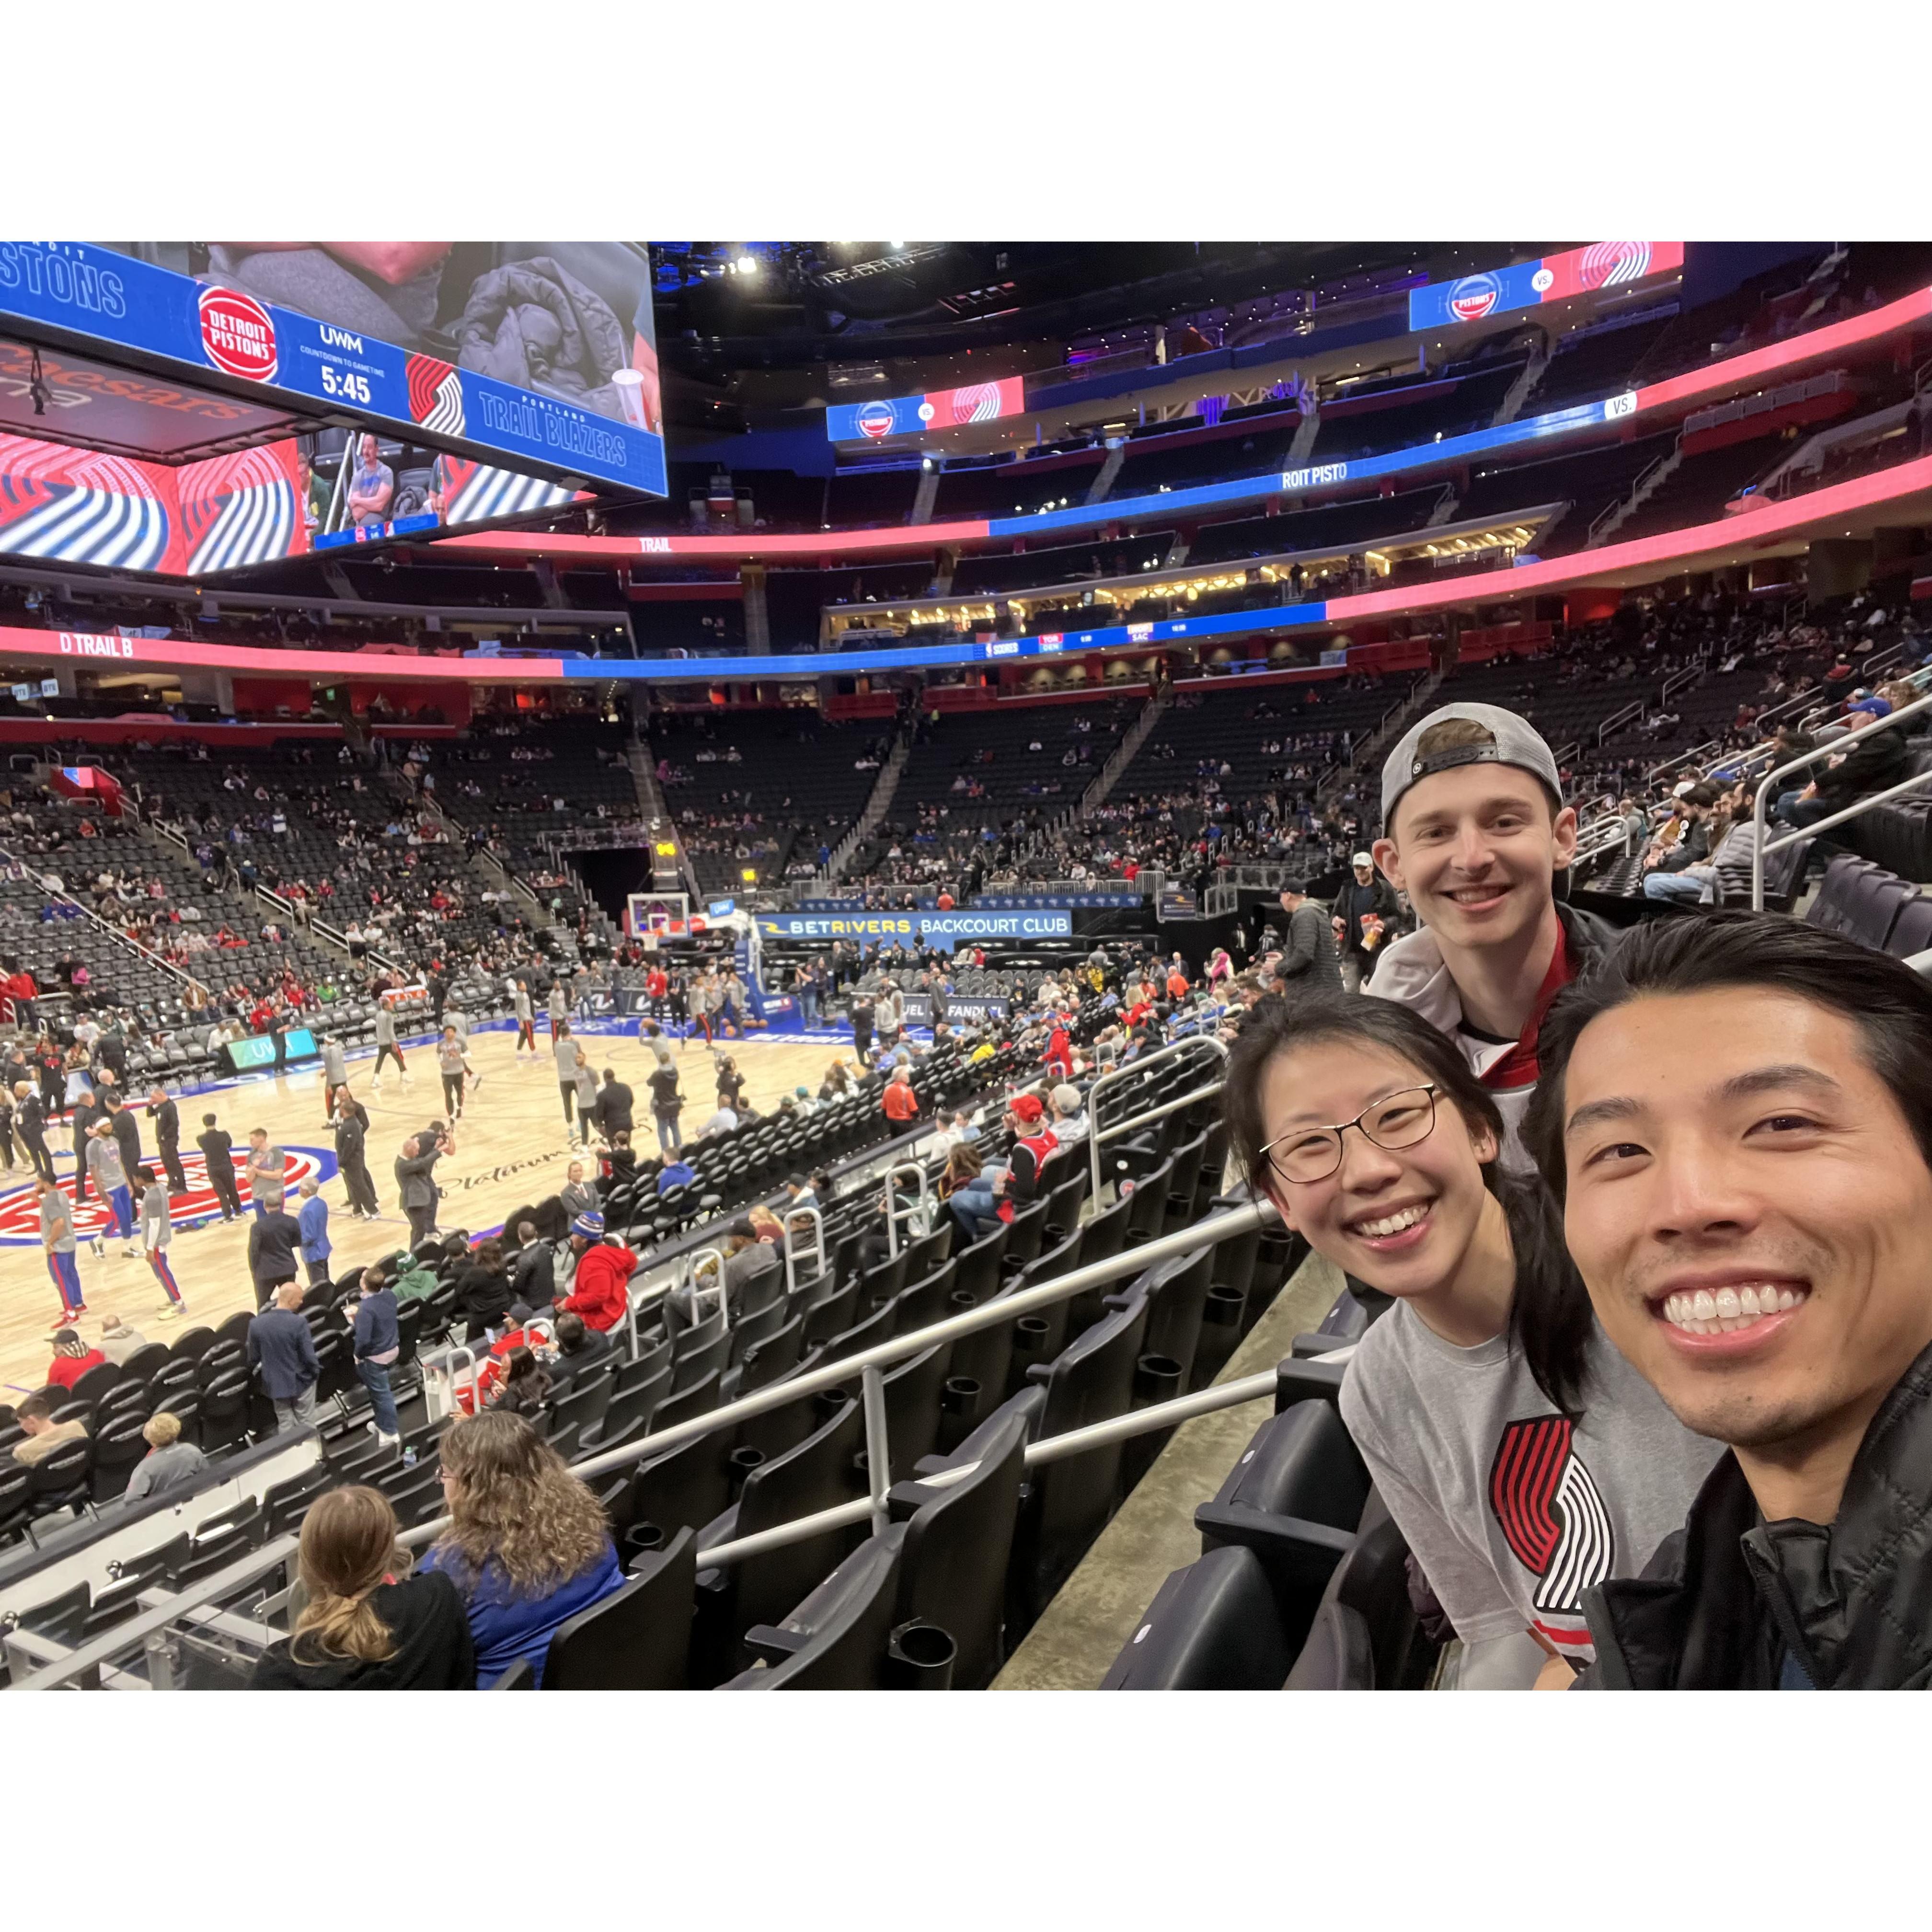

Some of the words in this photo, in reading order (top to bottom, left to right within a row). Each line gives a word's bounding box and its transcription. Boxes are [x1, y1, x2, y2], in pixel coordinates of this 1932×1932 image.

[0, 242, 126, 318] STONS
[1459, 294, 1490, 309] PISTONS
[207, 309, 266, 342] DETROIT
[209, 327, 269, 360] PISTONS
[320, 324, 363, 355] UWM
[300, 345, 343, 365] COUNTDOWN
[343, 358, 352, 368] TO
[353, 361, 385, 378] GAMETIME
[322, 365, 370, 404] 5:45
[522, 395, 585, 423] PORTLAND
[1613, 397, 1632, 414] VS.
[479, 391, 542, 442] TRAIL
[545, 413, 627, 467] BLAZERS
[1282, 468, 1310, 489] ROIT
[1312, 462, 1347, 484] PISTO
[639, 537, 672, 552] TRAIL
[60, 632, 71, 653] D
[73, 633, 121, 656] TRAIL
[121, 638, 133, 657] B
[1042, 635, 1059, 644] TOR
[1132, 633, 1149, 641] SAC
[790, 920, 911, 934] BETRIVERS
[920, 918, 1019, 933] BACKCOURT
[1023, 918, 1068, 932] CLUB
[948, 1004, 1005, 1018] FANDL
